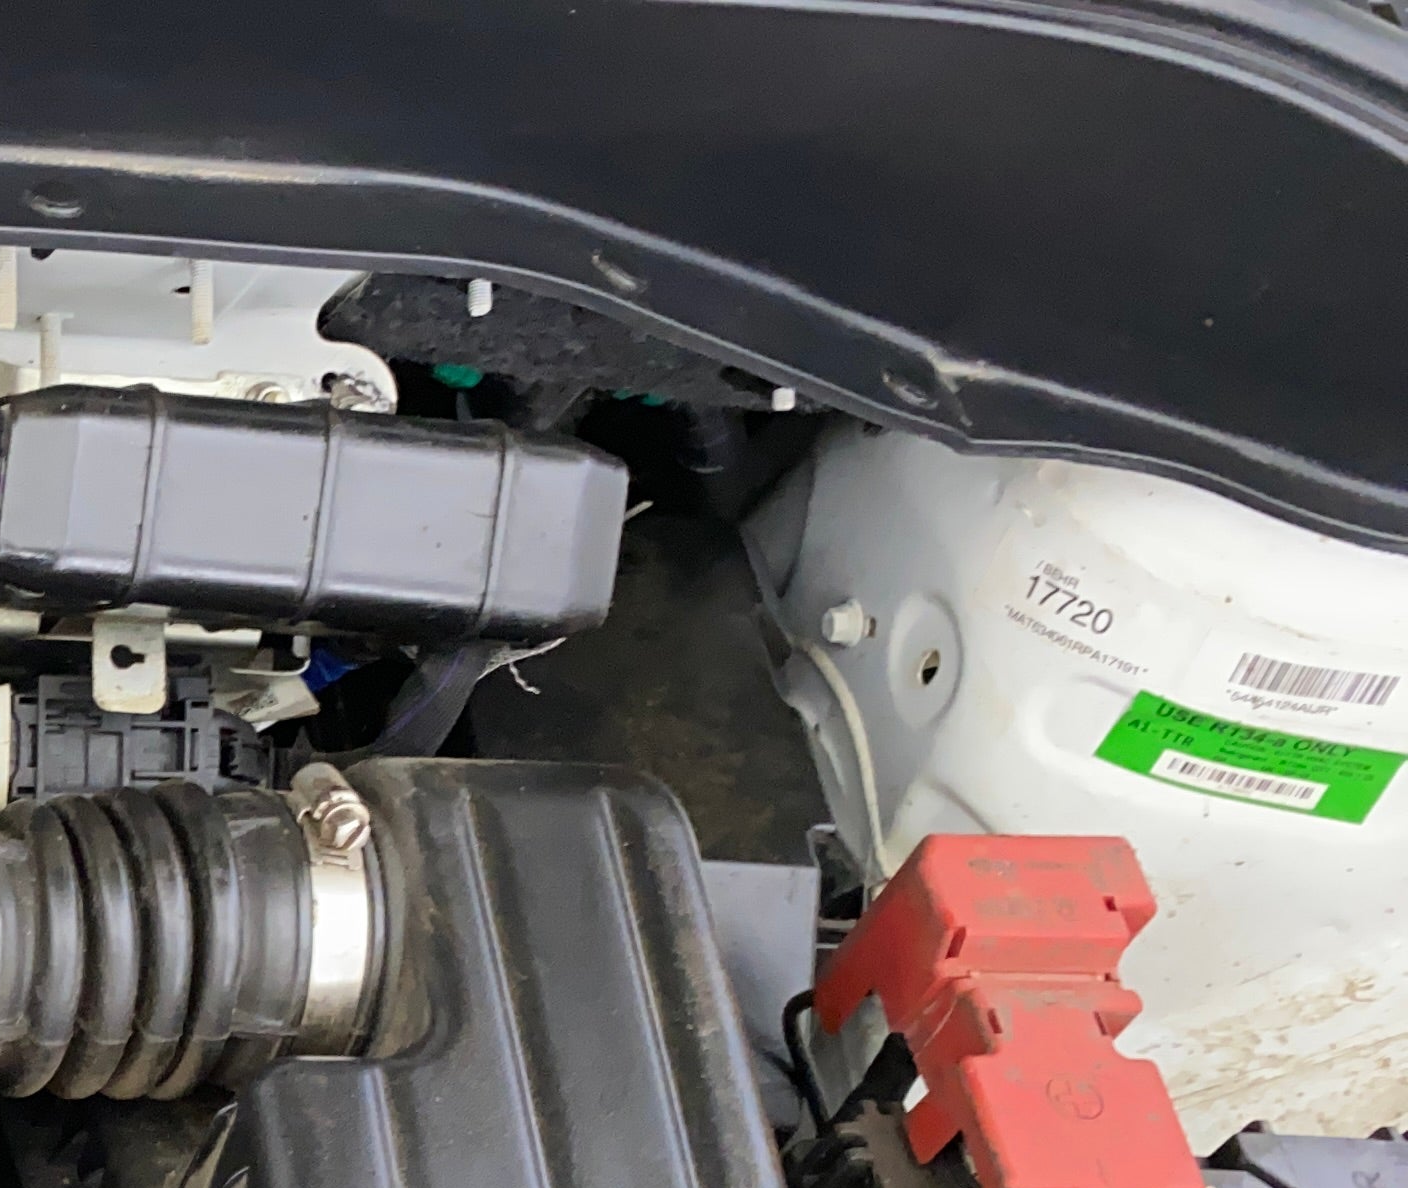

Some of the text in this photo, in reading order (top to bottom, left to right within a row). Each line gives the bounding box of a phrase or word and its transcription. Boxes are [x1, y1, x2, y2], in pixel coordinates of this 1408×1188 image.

[1026, 575, 1113, 634] 17720
[1156, 702, 1205, 728] USE
[1293, 738, 1353, 757] ONLY
